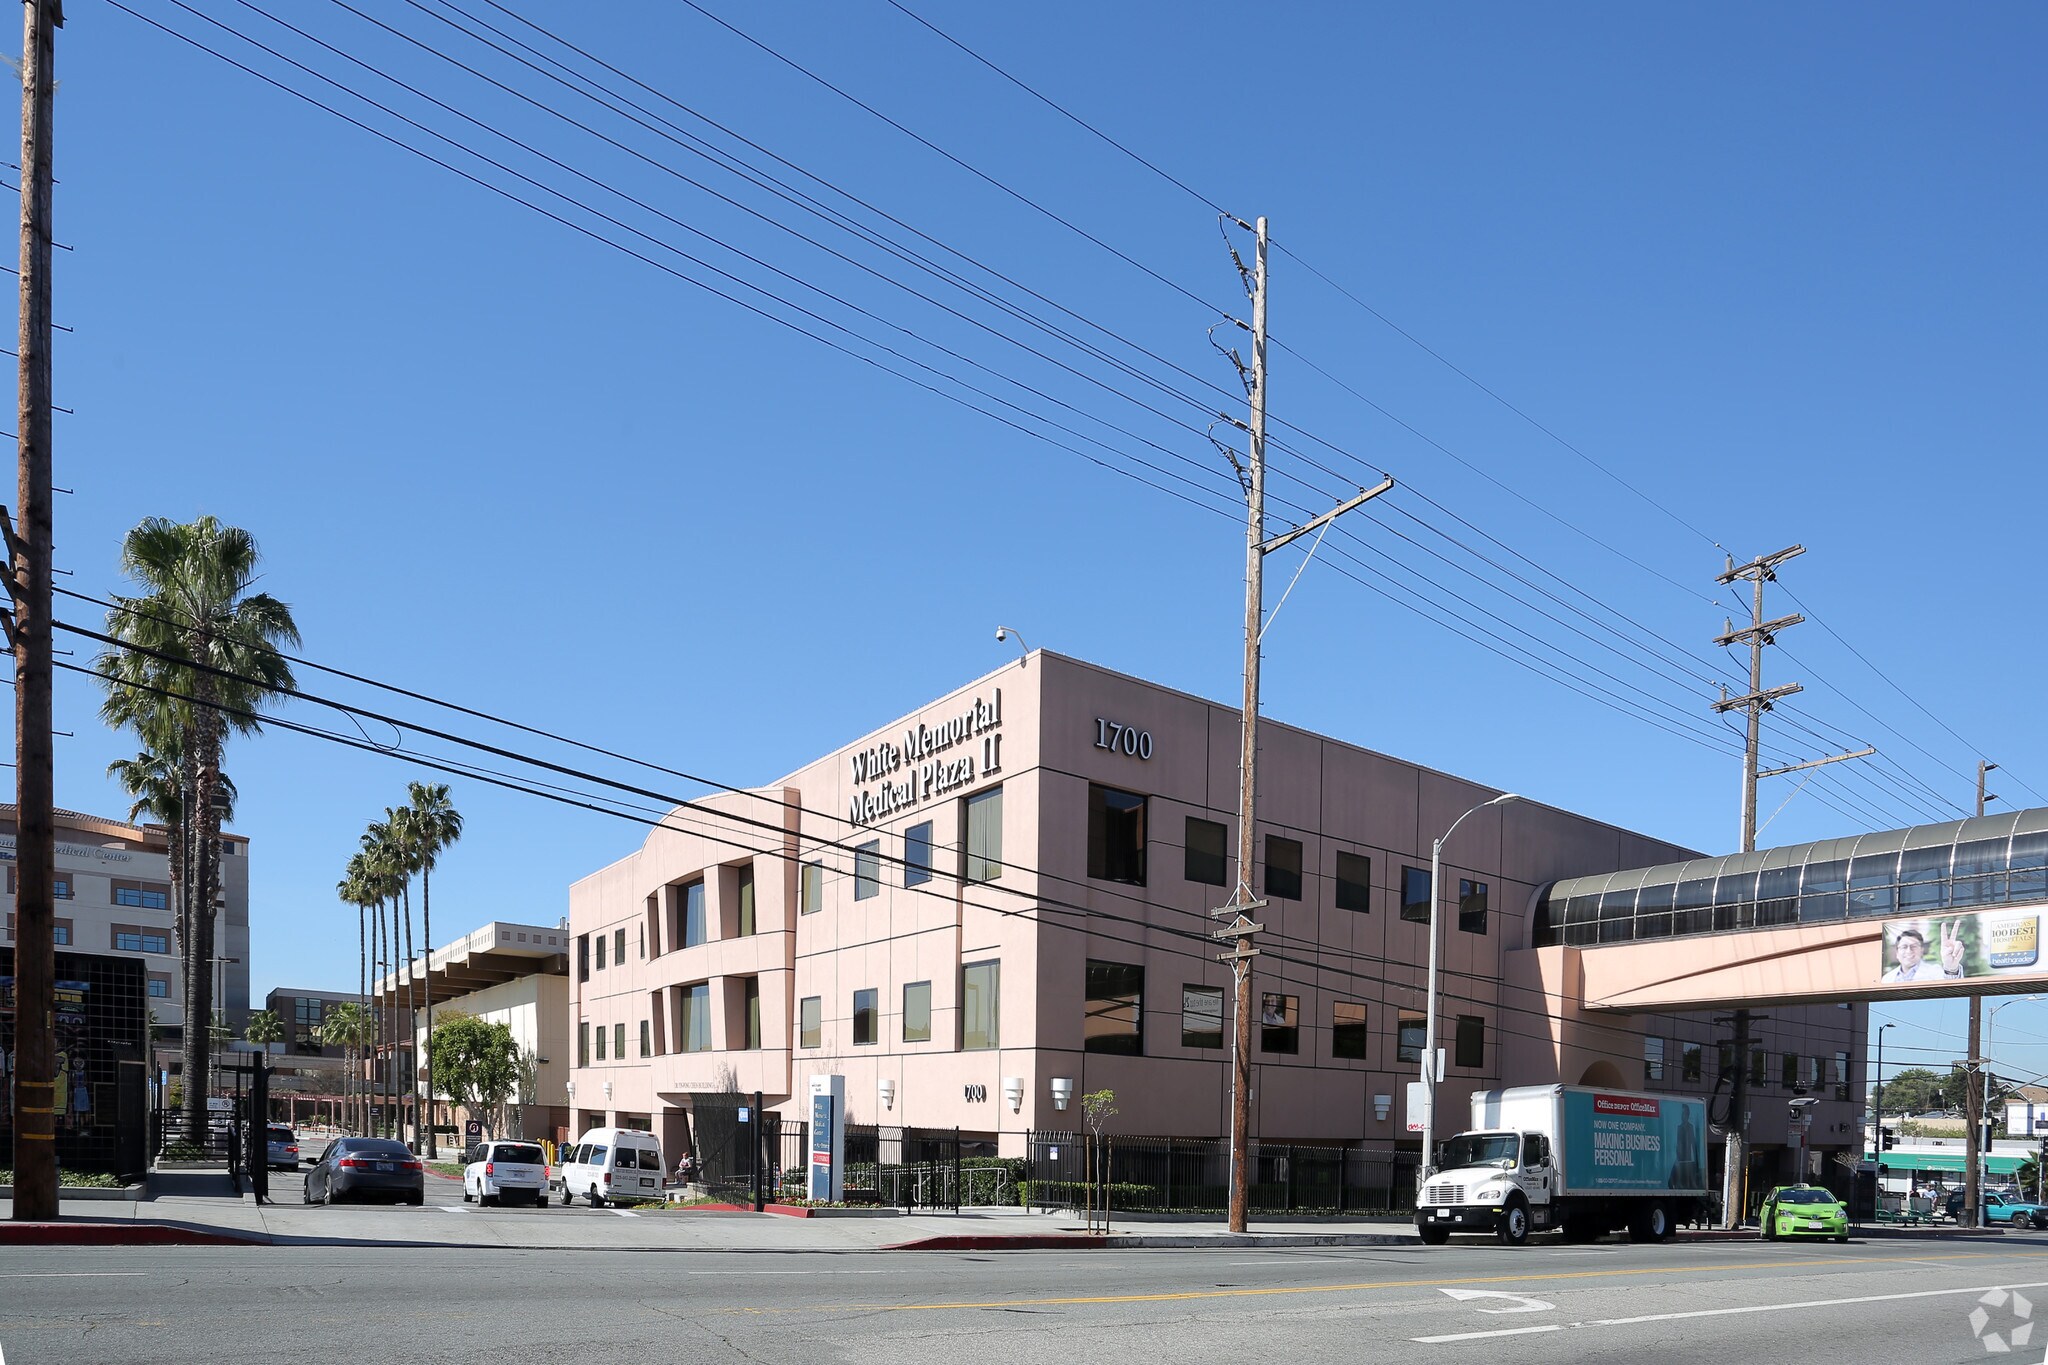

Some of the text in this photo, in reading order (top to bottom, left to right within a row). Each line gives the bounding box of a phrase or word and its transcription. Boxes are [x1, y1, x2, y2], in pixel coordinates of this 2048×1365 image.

[849, 687, 999, 785] White Memorial
[1096, 718, 1153, 759] 1700
[849, 734, 1000, 826] Medical Plaza II
[54, 844, 132, 862] edical Center
[1992, 926, 2036, 938] 100 BEST
[1996, 920, 2032, 930] AMERICA'S
[1992, 956, 2035, 965] healthgrades
[1597, 1099, 1656, 1113] Office DEPOT OfficeMax
[1593, 1120, 1646, 1131] NOW ONE COMPANY.
[1594, 1132, 1660, 1151] MAKING BUSINESS
